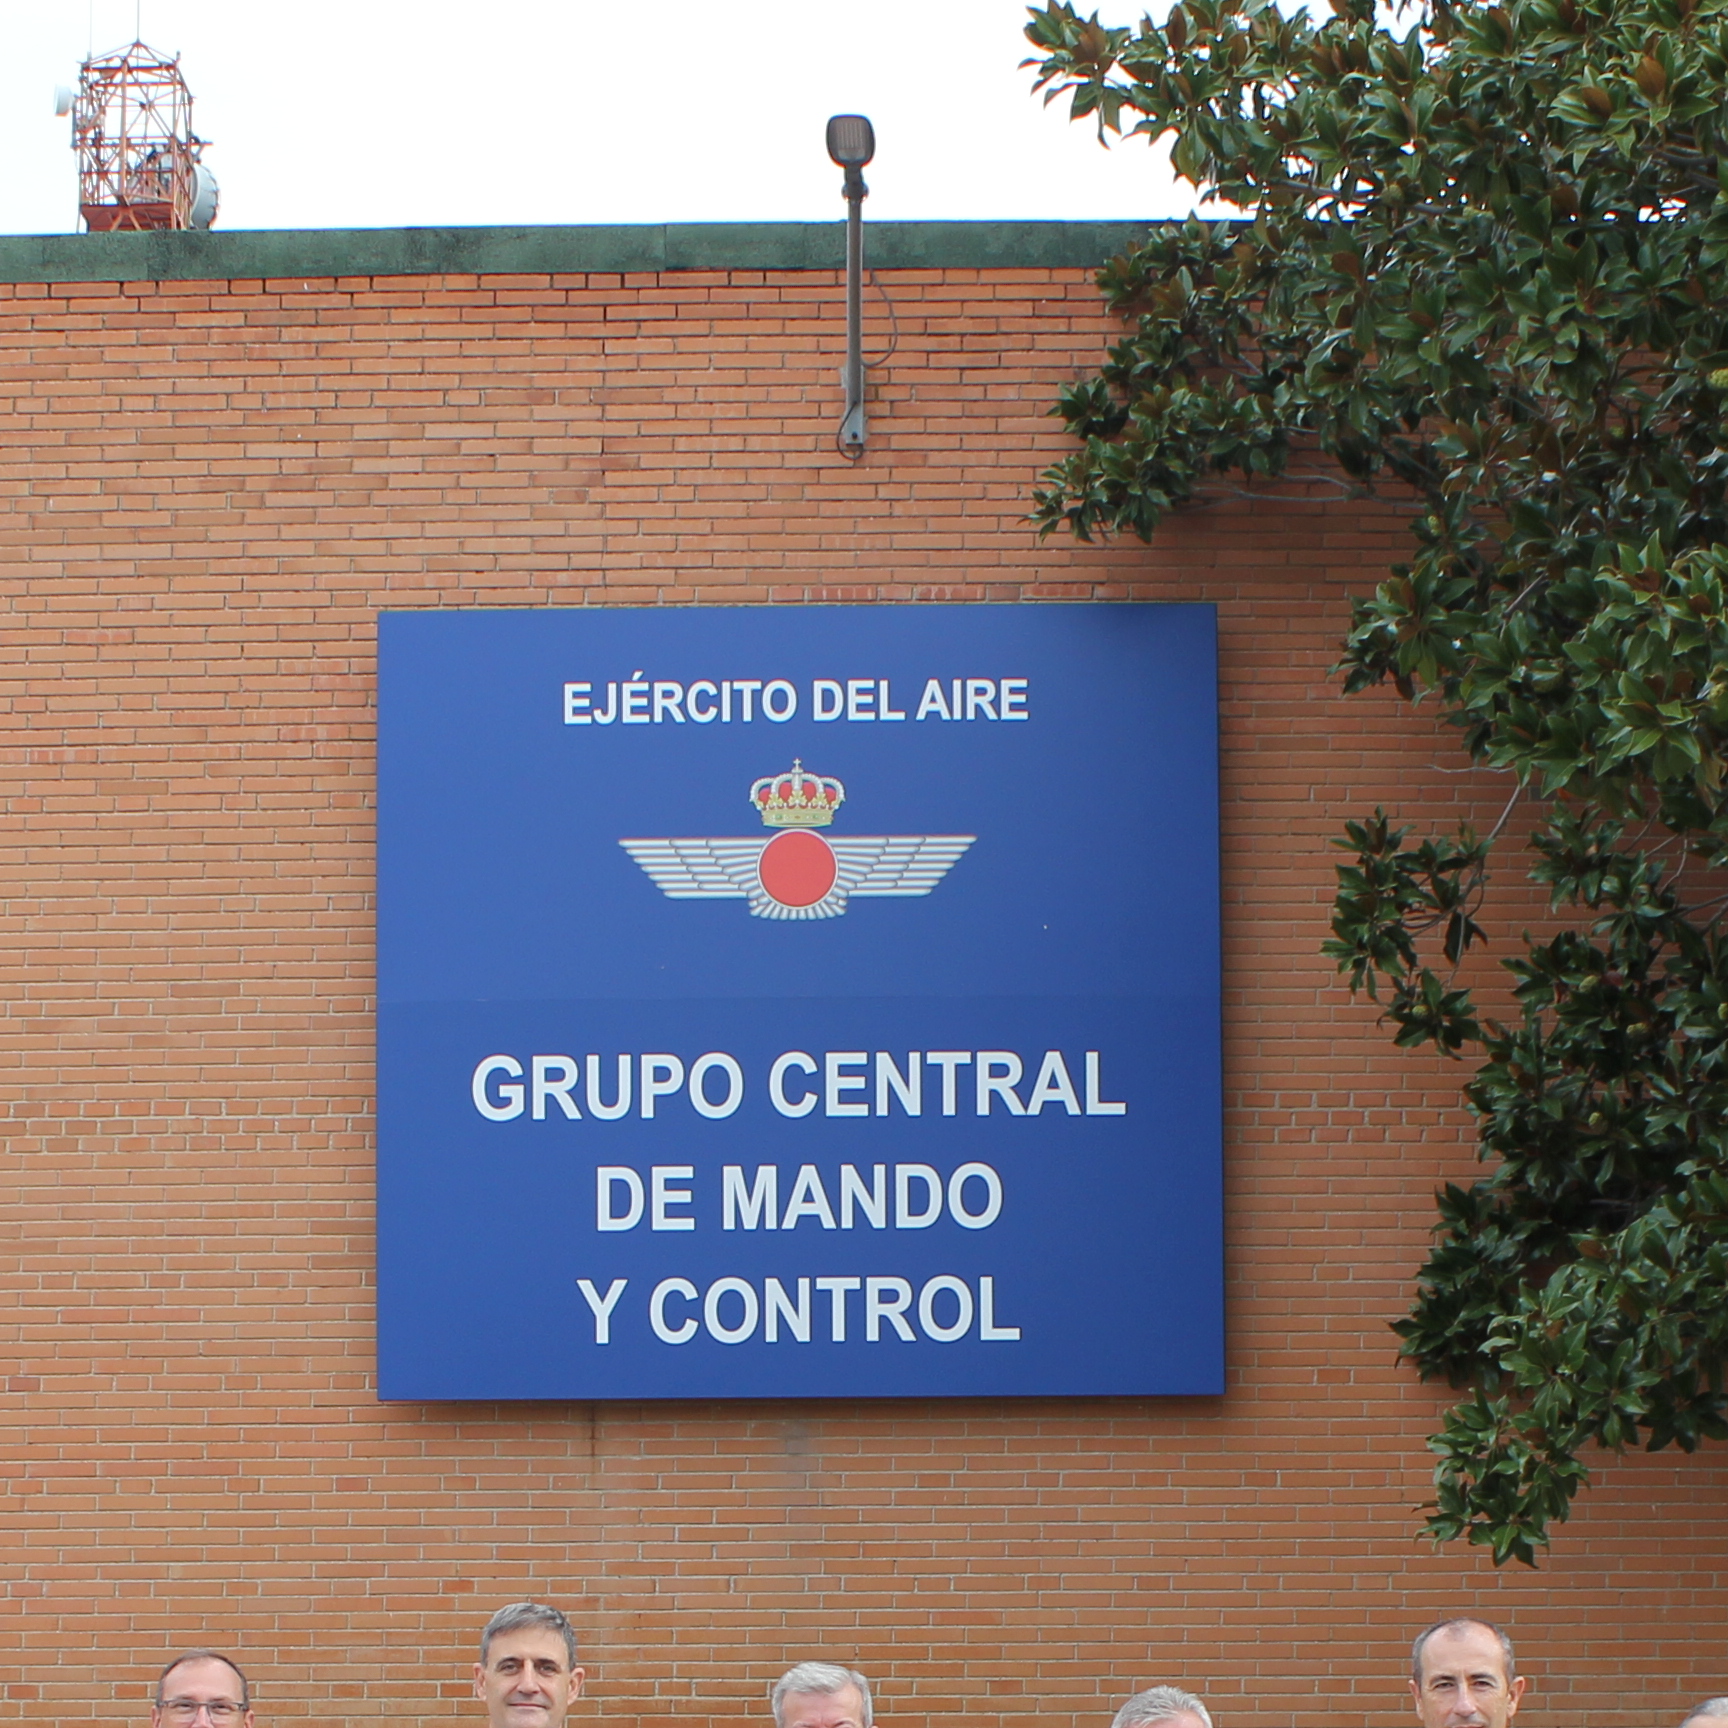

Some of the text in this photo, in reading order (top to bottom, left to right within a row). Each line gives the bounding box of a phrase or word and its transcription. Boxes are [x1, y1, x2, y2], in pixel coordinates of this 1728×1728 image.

[563, 670, 1029, 724] EJÉRCITO DEL AIRE
[472, 1050, 1127, 1121] GRUPO CENTRAL
[597, 1162, 1002, 1231] DE MANDO
[576, 1275, 1021, 1344] Y CONTROL
